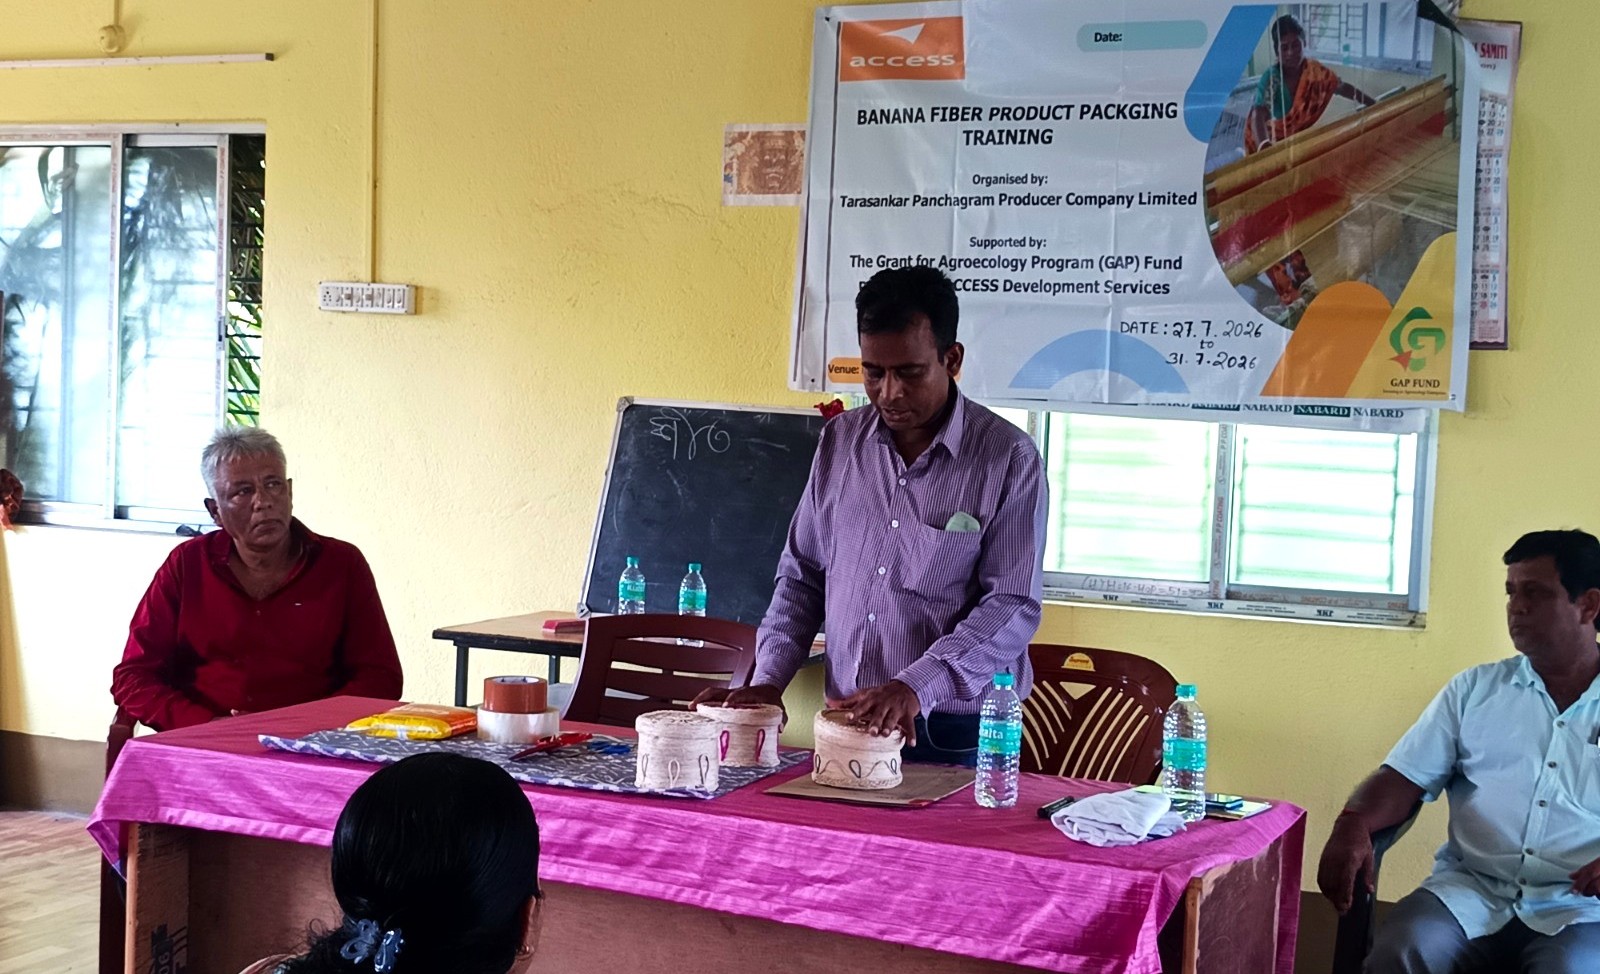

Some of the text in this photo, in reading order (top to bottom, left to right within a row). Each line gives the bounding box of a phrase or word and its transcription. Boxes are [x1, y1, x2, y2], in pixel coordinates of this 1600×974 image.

[1094, 31, 1123, 43] Date:
[849, 52, 956, 68] access
[857, 102, 1178, 126] BANANA FIBER PRODUCT PACKGING
[963, 128, 1053, 146] TRAINING
[972, 173, 1048, 186] Organised by:
[839, 191, 1198, 209] Tarasankar Panchagram Producer Company Limited
[969, 236, 1047, 250] Supported by:
[849, 254, 1183, 273] The Grant for Agroecology Program (GAP) Fund
[954, 279, 1171, 297] CCESS Development Services
[1200, 339, 1215, 350] to
[828, 364, 860, 375] Venue:
[1390, 378, 1441, 389] GAP FUND
[1242, 404, 1293, 413] NABARD
[1297, 405, 1348, 416] NABARD
[1353, 407, 1405, 419] NABARD
